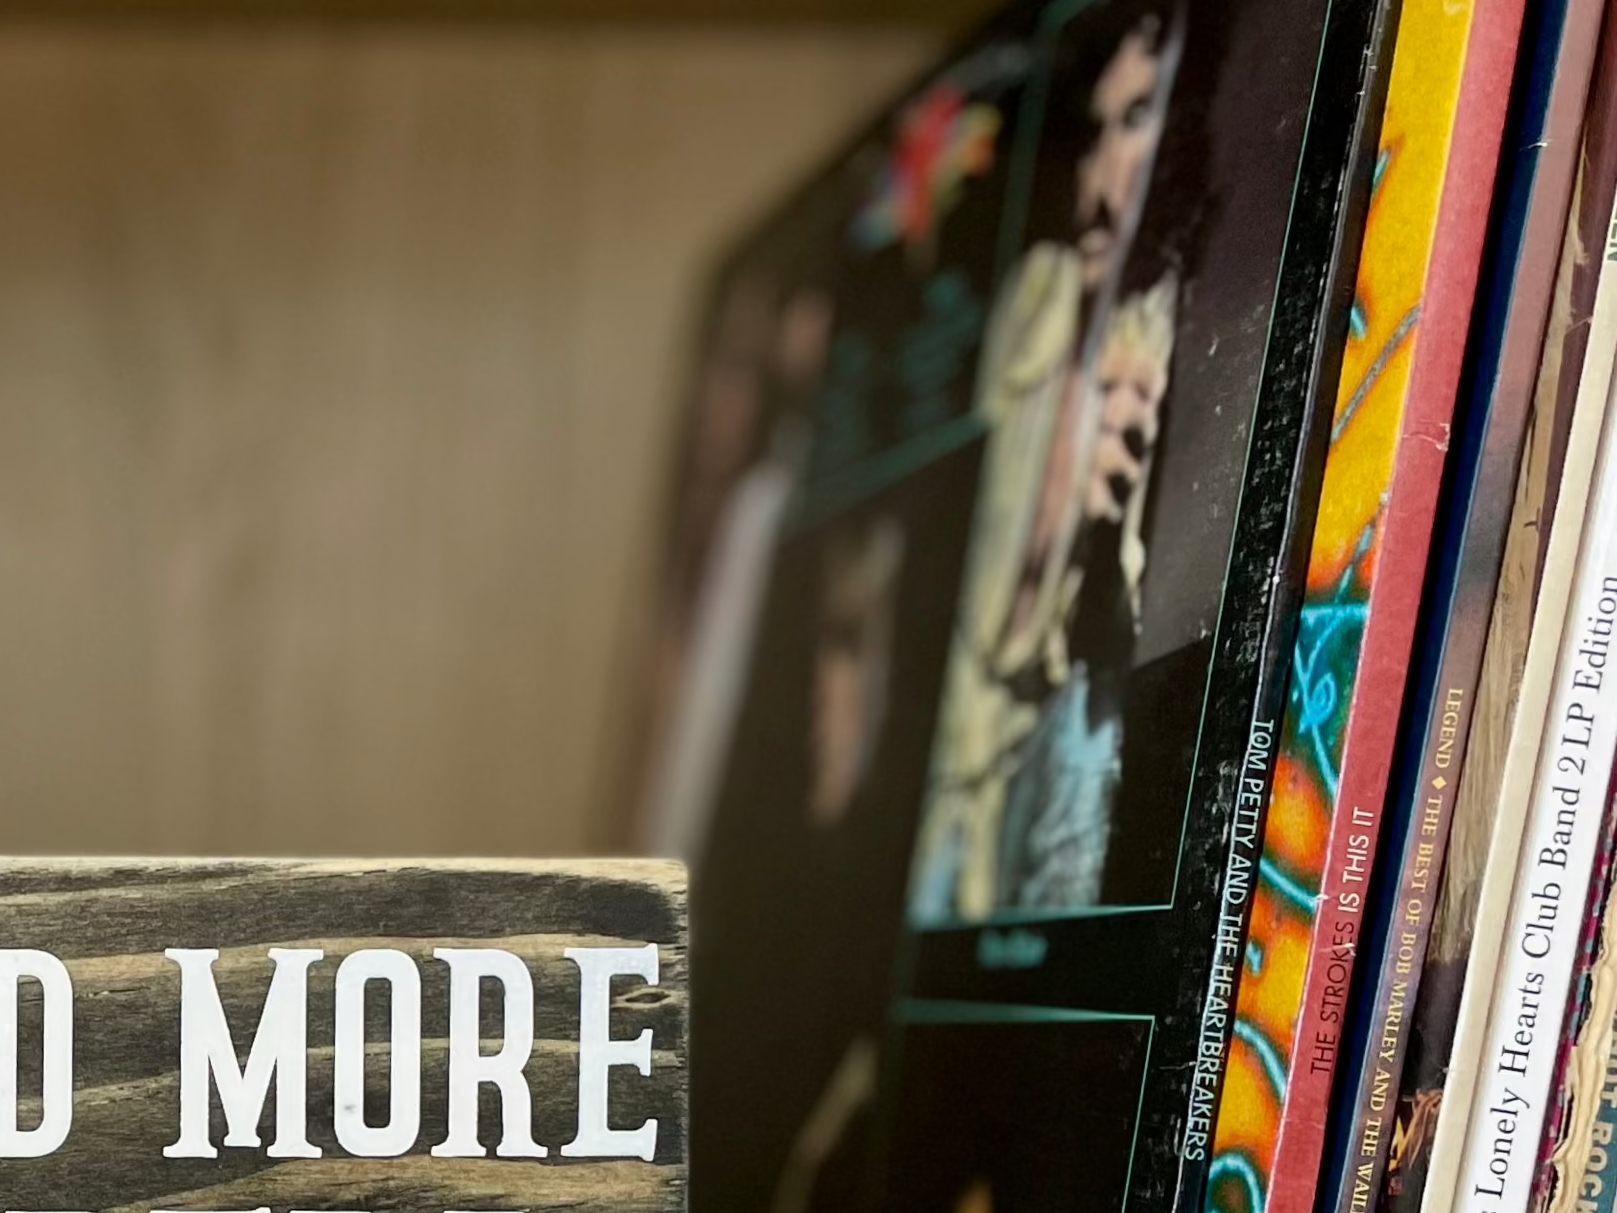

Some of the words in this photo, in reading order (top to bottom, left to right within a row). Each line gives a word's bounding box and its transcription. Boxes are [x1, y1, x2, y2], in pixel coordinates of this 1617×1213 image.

[1572, 574, 1617, 693] Edition
[1245, 718, 1274, 773] TOM
[1434, 688, 1463, 770] LEGEND
[1563, 704, 1596, 750] LP
[1559, 755, 1587, 778] 2
[1229, 778, 1263, 849] PETTY
[1355, 806, 1376, 828] IT
[1422, 795, 1443, 833] THE
[1540, 784, 1586, 869] Band
[1224, 855, 1254, 906] AND
[1342, 831, 1371, 883] THIS
[1411, 836, 1436, 895] BEST
[1337, 887, 1360, 913] IS
[1403, 899, 1423, 928] OF
[1521, 880, 1565, 960] Club
[1216, 912, 1244, 962] THE
[1396, 932, 1419, 975] BOB
[1320, 920, 1355, 1030] STROKES
[1380, 980, 1411, 1066] MARLEY
[1498, 970, 1546, 1078] Hearts
[162, 941, 661, 1164] MORE
[1184, 964, 1235, 1164] HEARTBREAKERS
[1310, 1031, 1336, 1075] THE
[1369, 1068, 1392, 1114] AND
[1359, 1114, 1382, 1159] THE
[1475, 1086, 1531, 1201] Lonely
